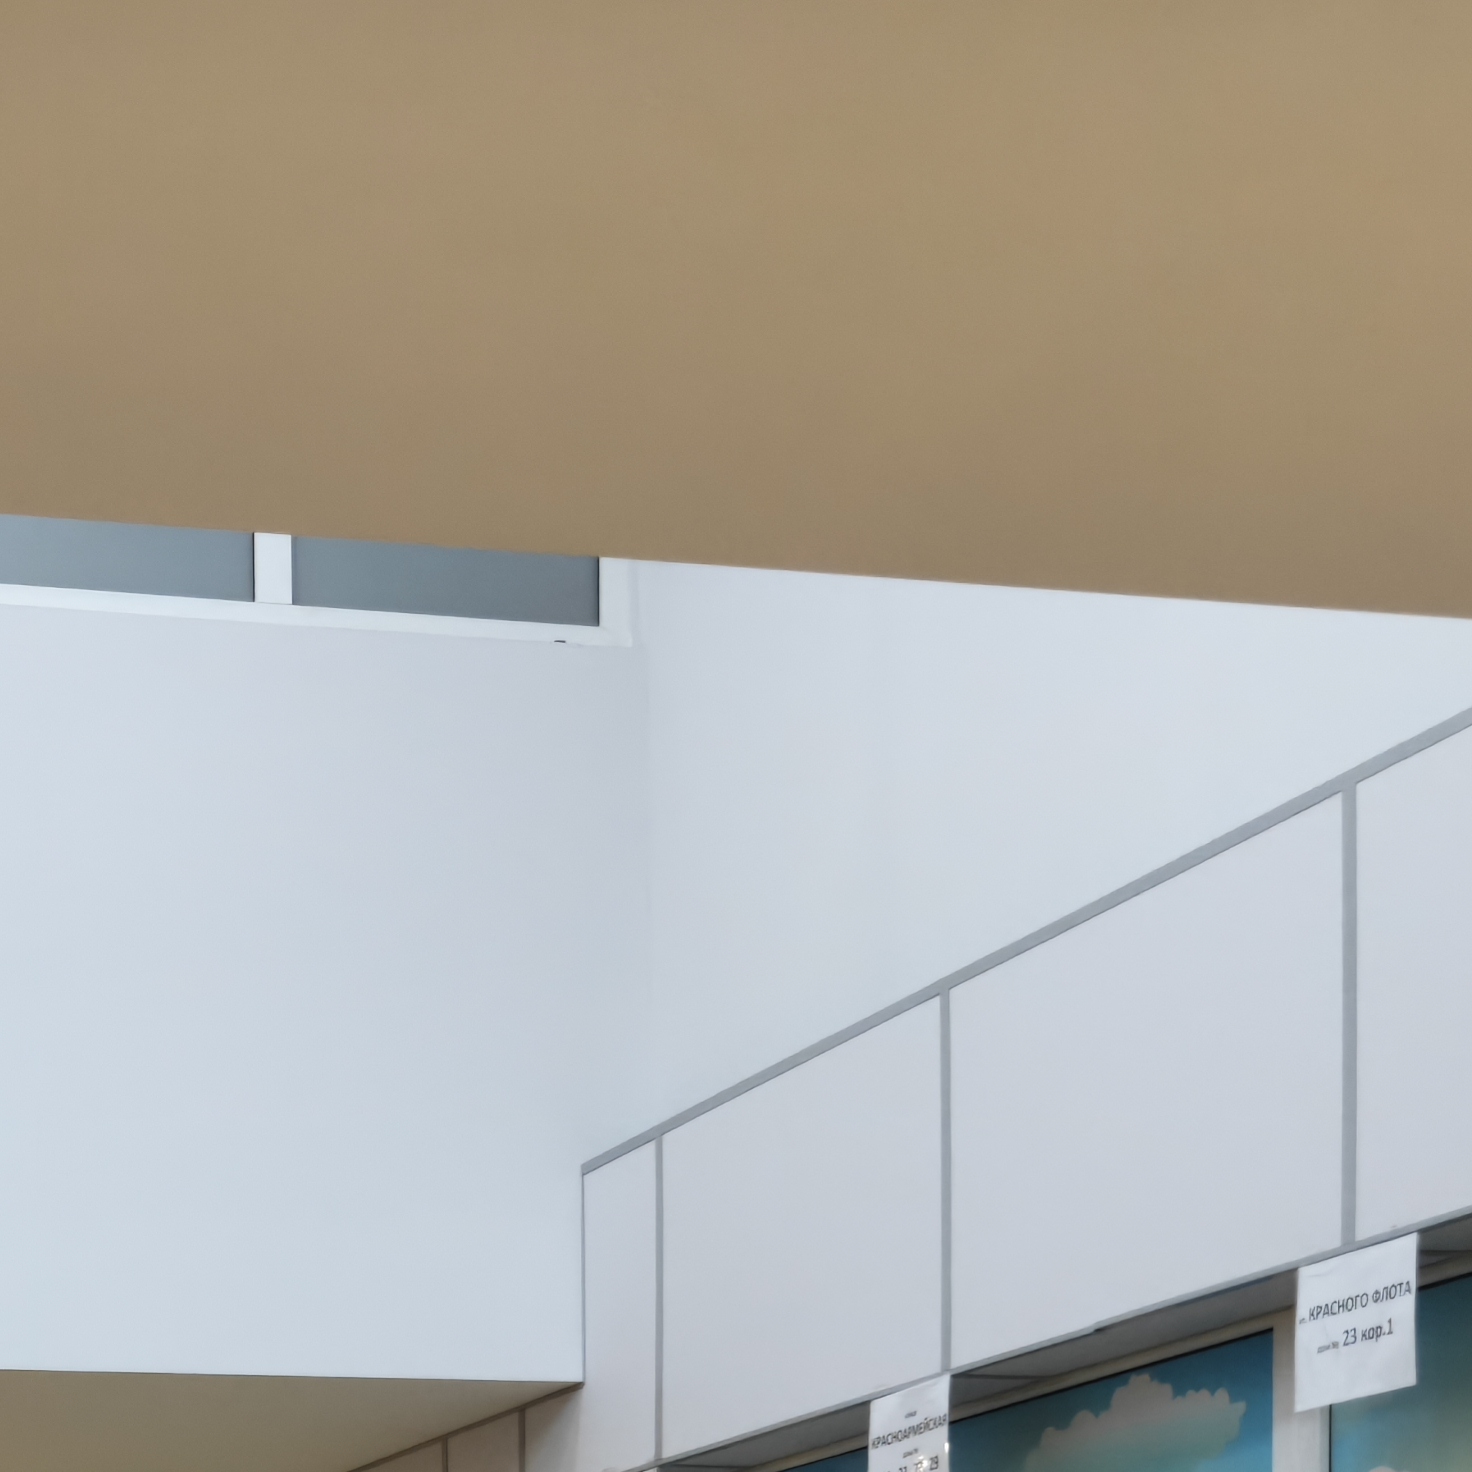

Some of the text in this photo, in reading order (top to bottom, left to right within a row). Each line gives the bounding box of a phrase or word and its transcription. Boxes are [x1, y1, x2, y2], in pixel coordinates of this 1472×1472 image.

[1308, 1280, 1412, 1322] КРАСНОГО ФЛОТА
[1342, 1327, 1357, 1347] 23
